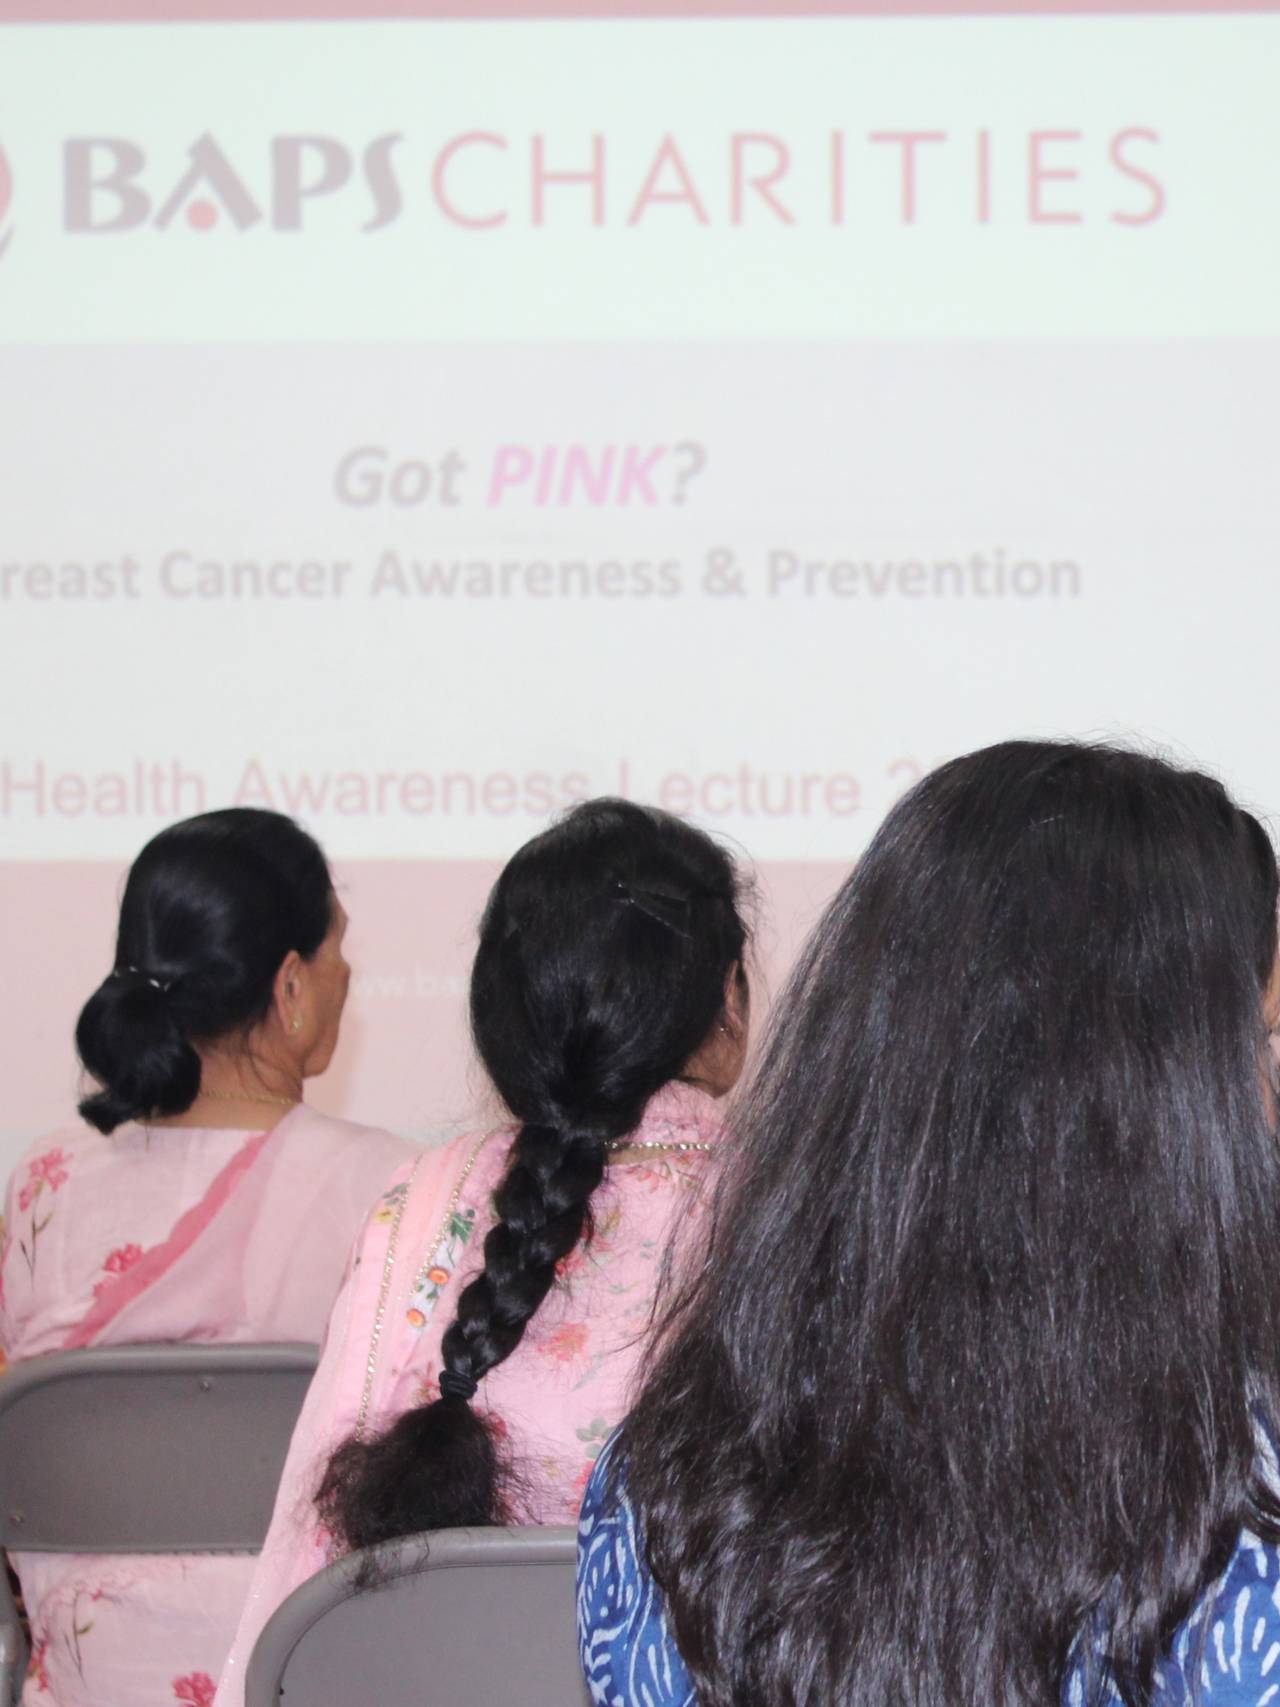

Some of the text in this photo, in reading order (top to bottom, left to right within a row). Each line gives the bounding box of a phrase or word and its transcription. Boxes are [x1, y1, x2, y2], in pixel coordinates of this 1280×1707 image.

[61, 125, 1167, 234] BAPS CHARITIES
[333, 439, 708, 509] Got PINK?
[158, 550, 352, 600] Cancer
[369, 549, 682, 600] Awareness
[700, 549, 747, 599] &
[767, 548, 1081, 600] Prevention
[1, 757, 206, 818] Health
[232, 757, 591, 818] Awareness
